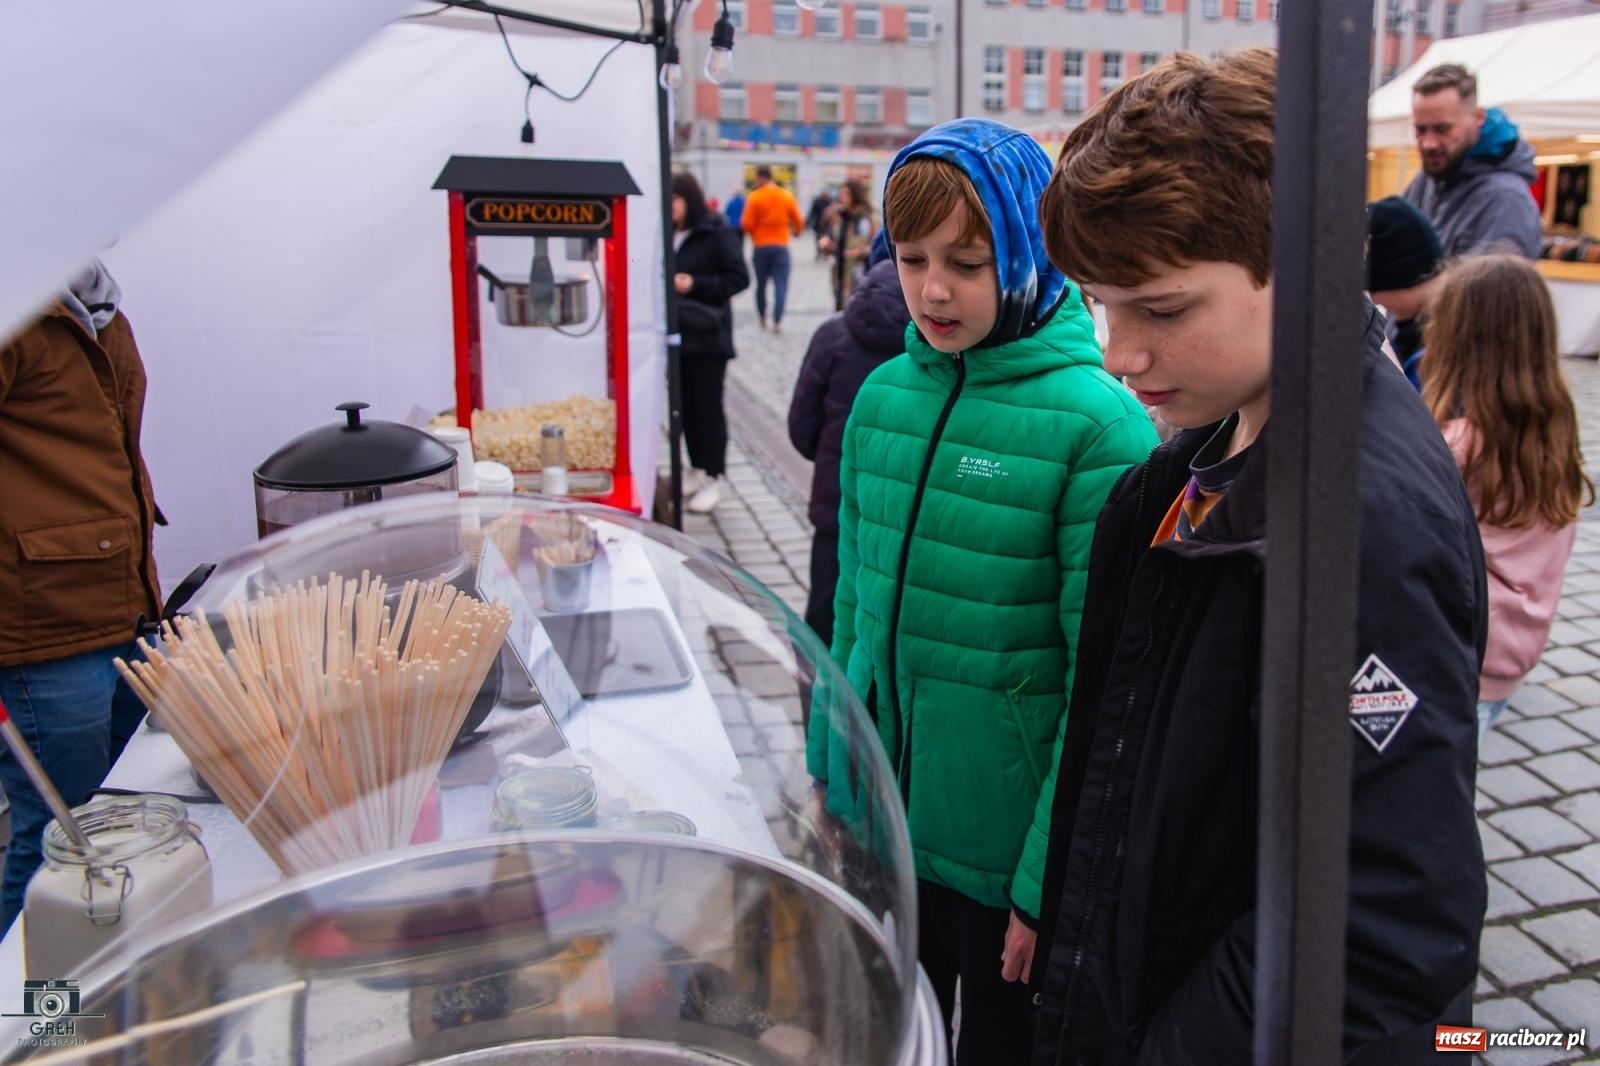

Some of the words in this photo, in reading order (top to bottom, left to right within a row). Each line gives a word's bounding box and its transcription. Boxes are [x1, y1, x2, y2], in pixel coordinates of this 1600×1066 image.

[482, 201, 595, 223] POPCORN
[960, 456, 1001, 468] B.YRSLF
[1350, 695, 1380, 705] ORTH
